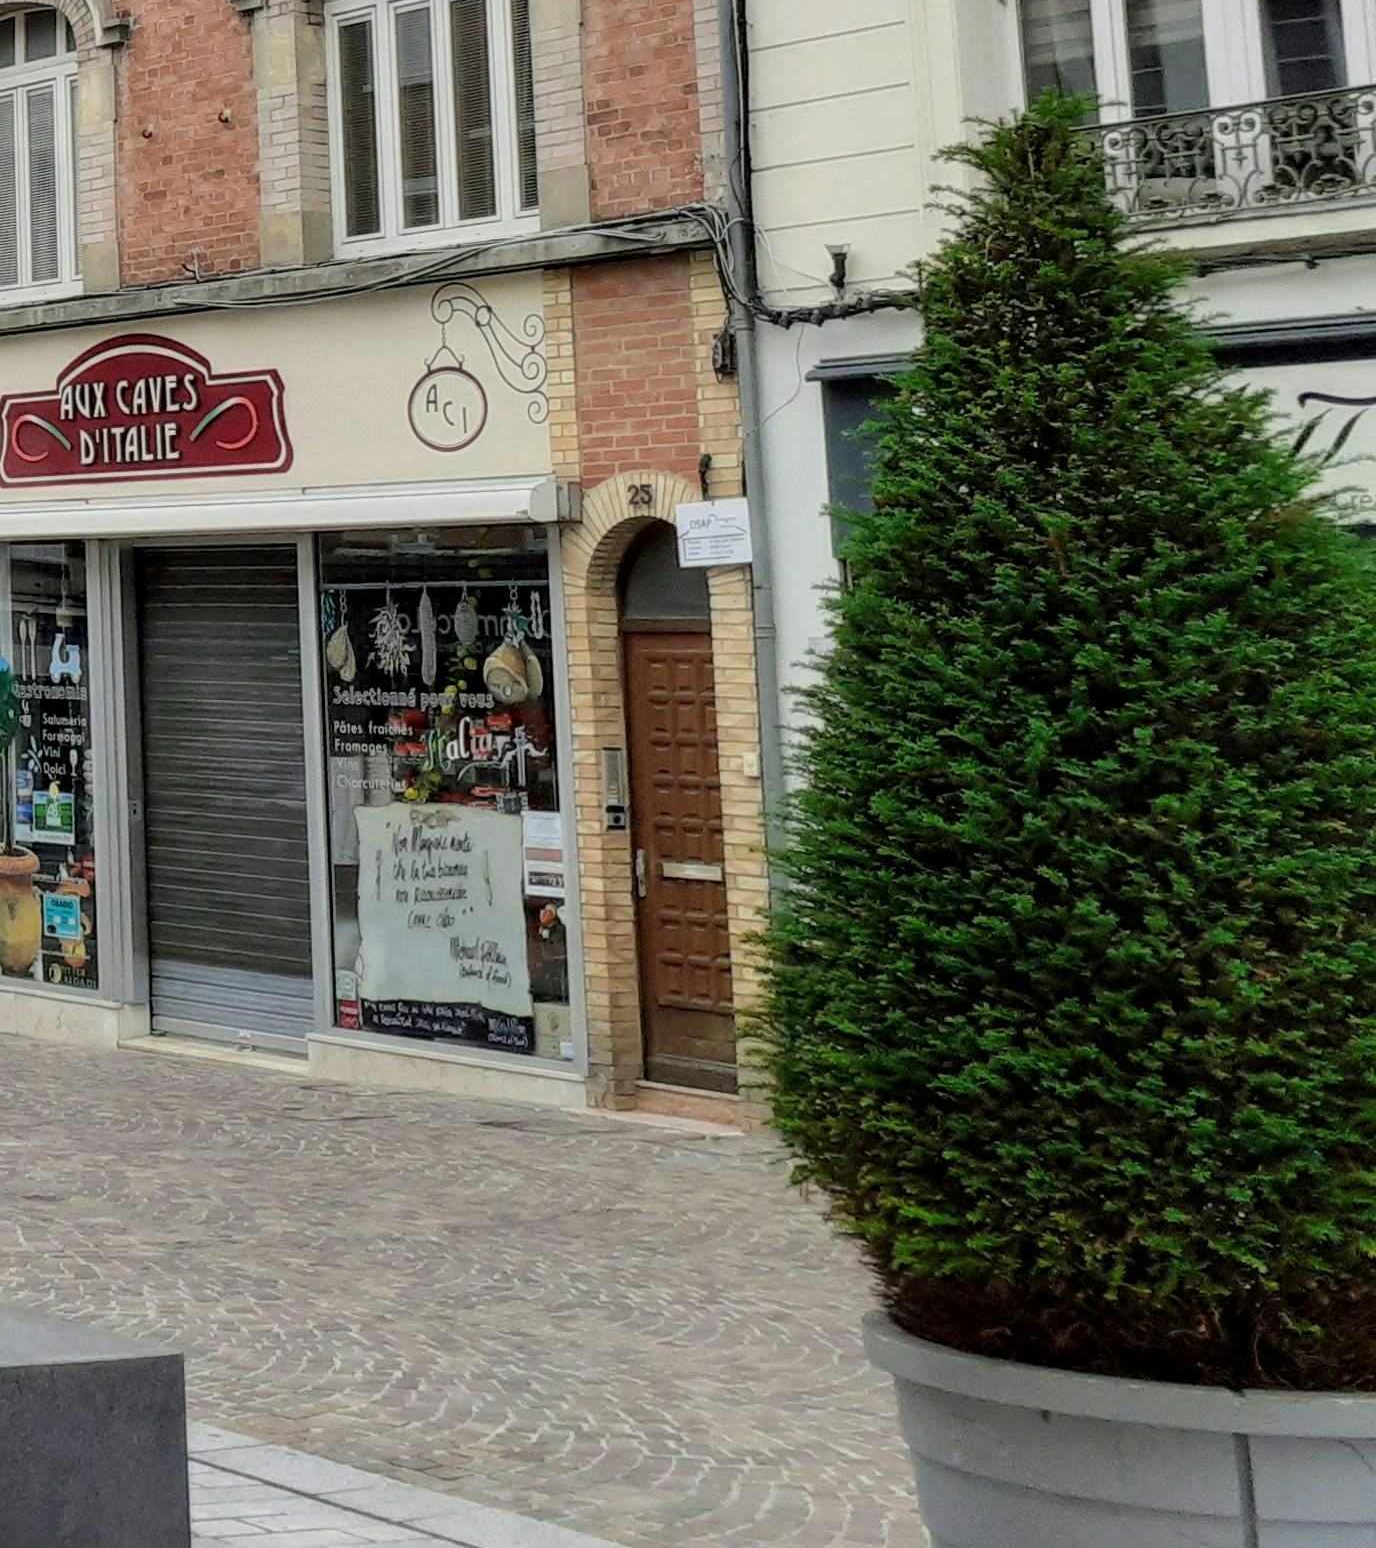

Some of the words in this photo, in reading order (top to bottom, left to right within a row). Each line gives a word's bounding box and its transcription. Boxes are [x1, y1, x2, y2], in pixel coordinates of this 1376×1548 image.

[59, 382, 106, 421] AUX
[115, 373, 198, 415] CAVES
[78, 422, 181, 465] D'ITALIE
[627, 484, 653, 505] 25
[459, 692, 495, 709] vous
[42, 712, 87, 727] Salumeria
[333, 720, 363, 735] Pâtes
[42, 728, 85, 746] Formaggi
[43, 744, 61, 758] Vini
[334, 738, 388, 754] Fromages
[42, 762, 66, 775] Dolci
[336, 775, 407, 793] Charcuteries
